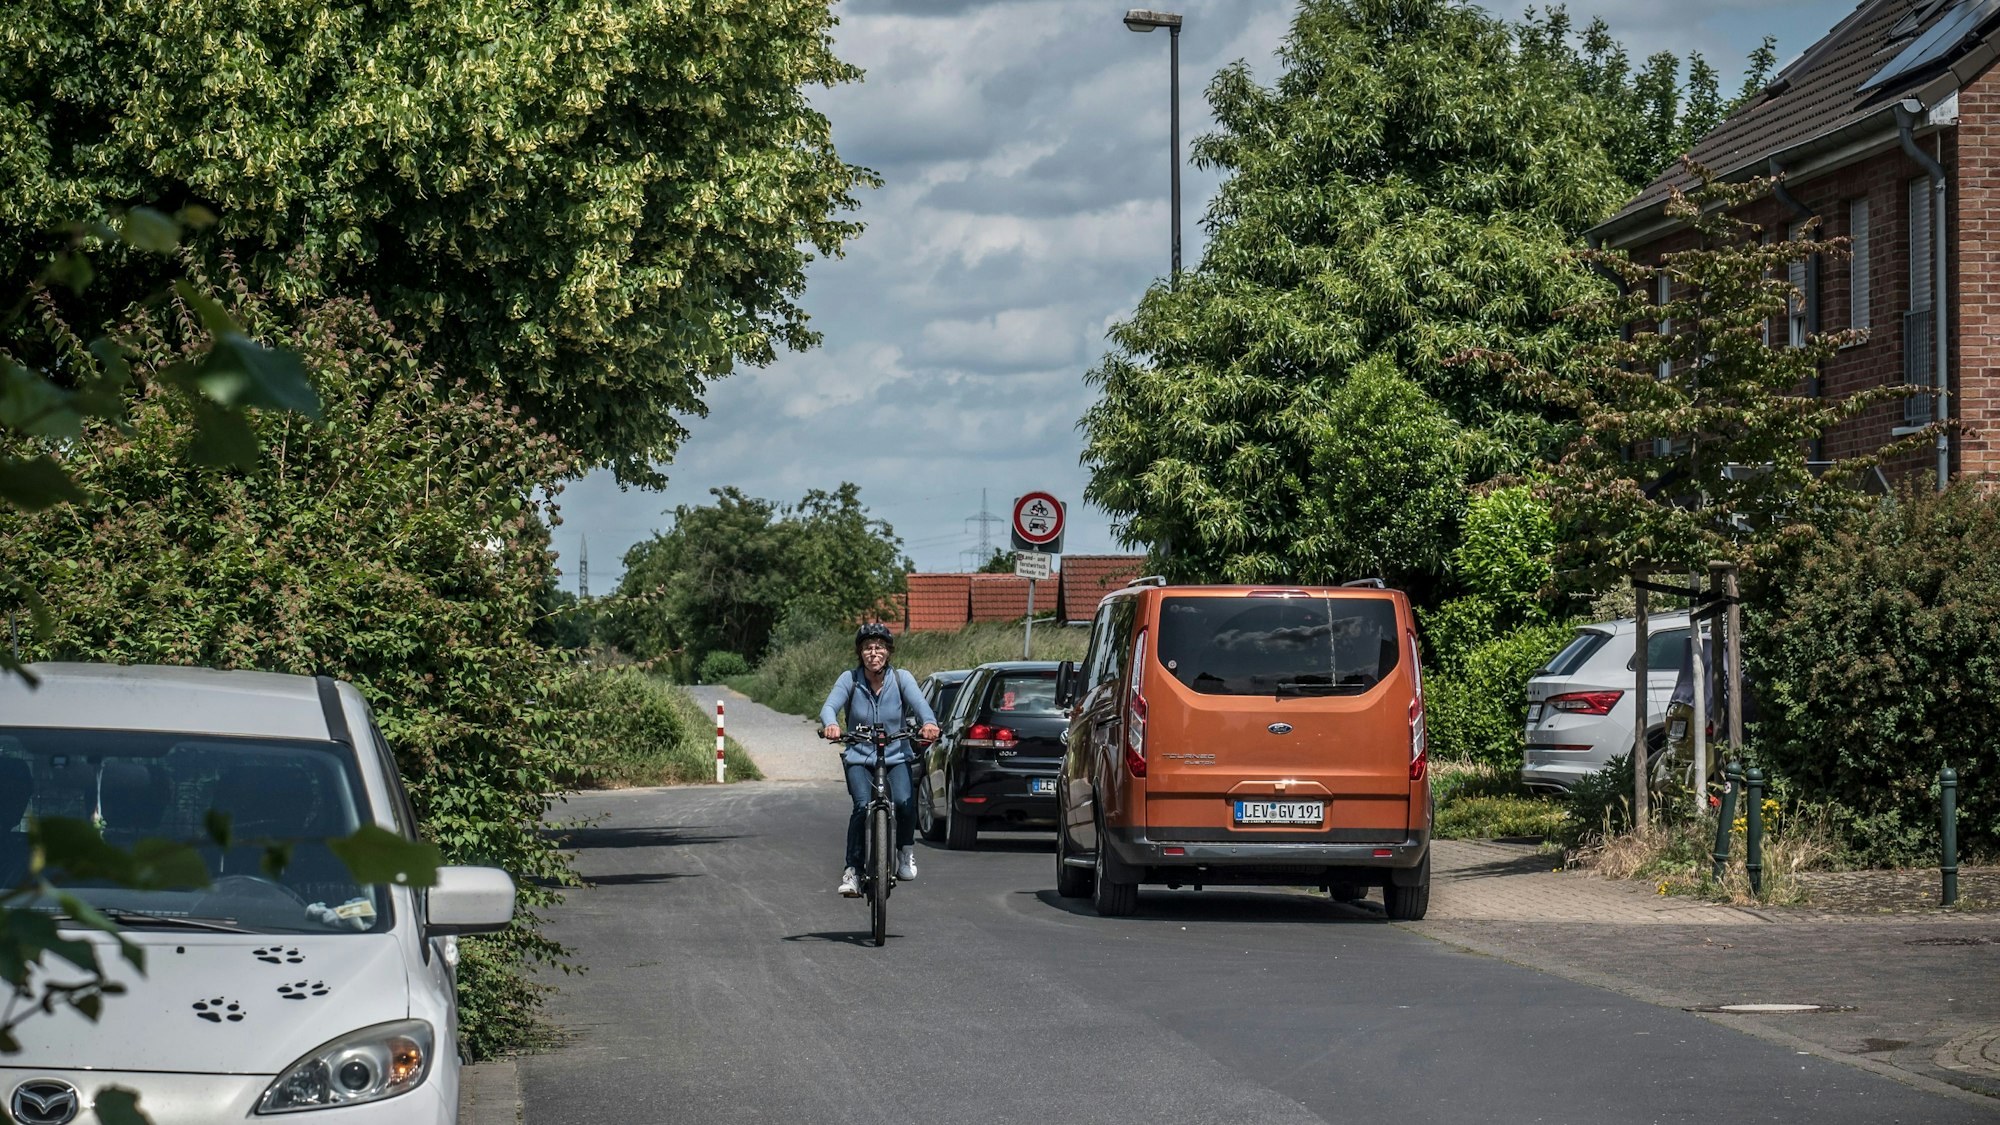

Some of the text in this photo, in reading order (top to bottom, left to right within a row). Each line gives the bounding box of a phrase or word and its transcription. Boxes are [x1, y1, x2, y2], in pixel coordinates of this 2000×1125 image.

[1244, 804, 1269, 818] LEV
[1279, 804, 1295, 818] GV
[1298, 805, 1322, 819] 191
